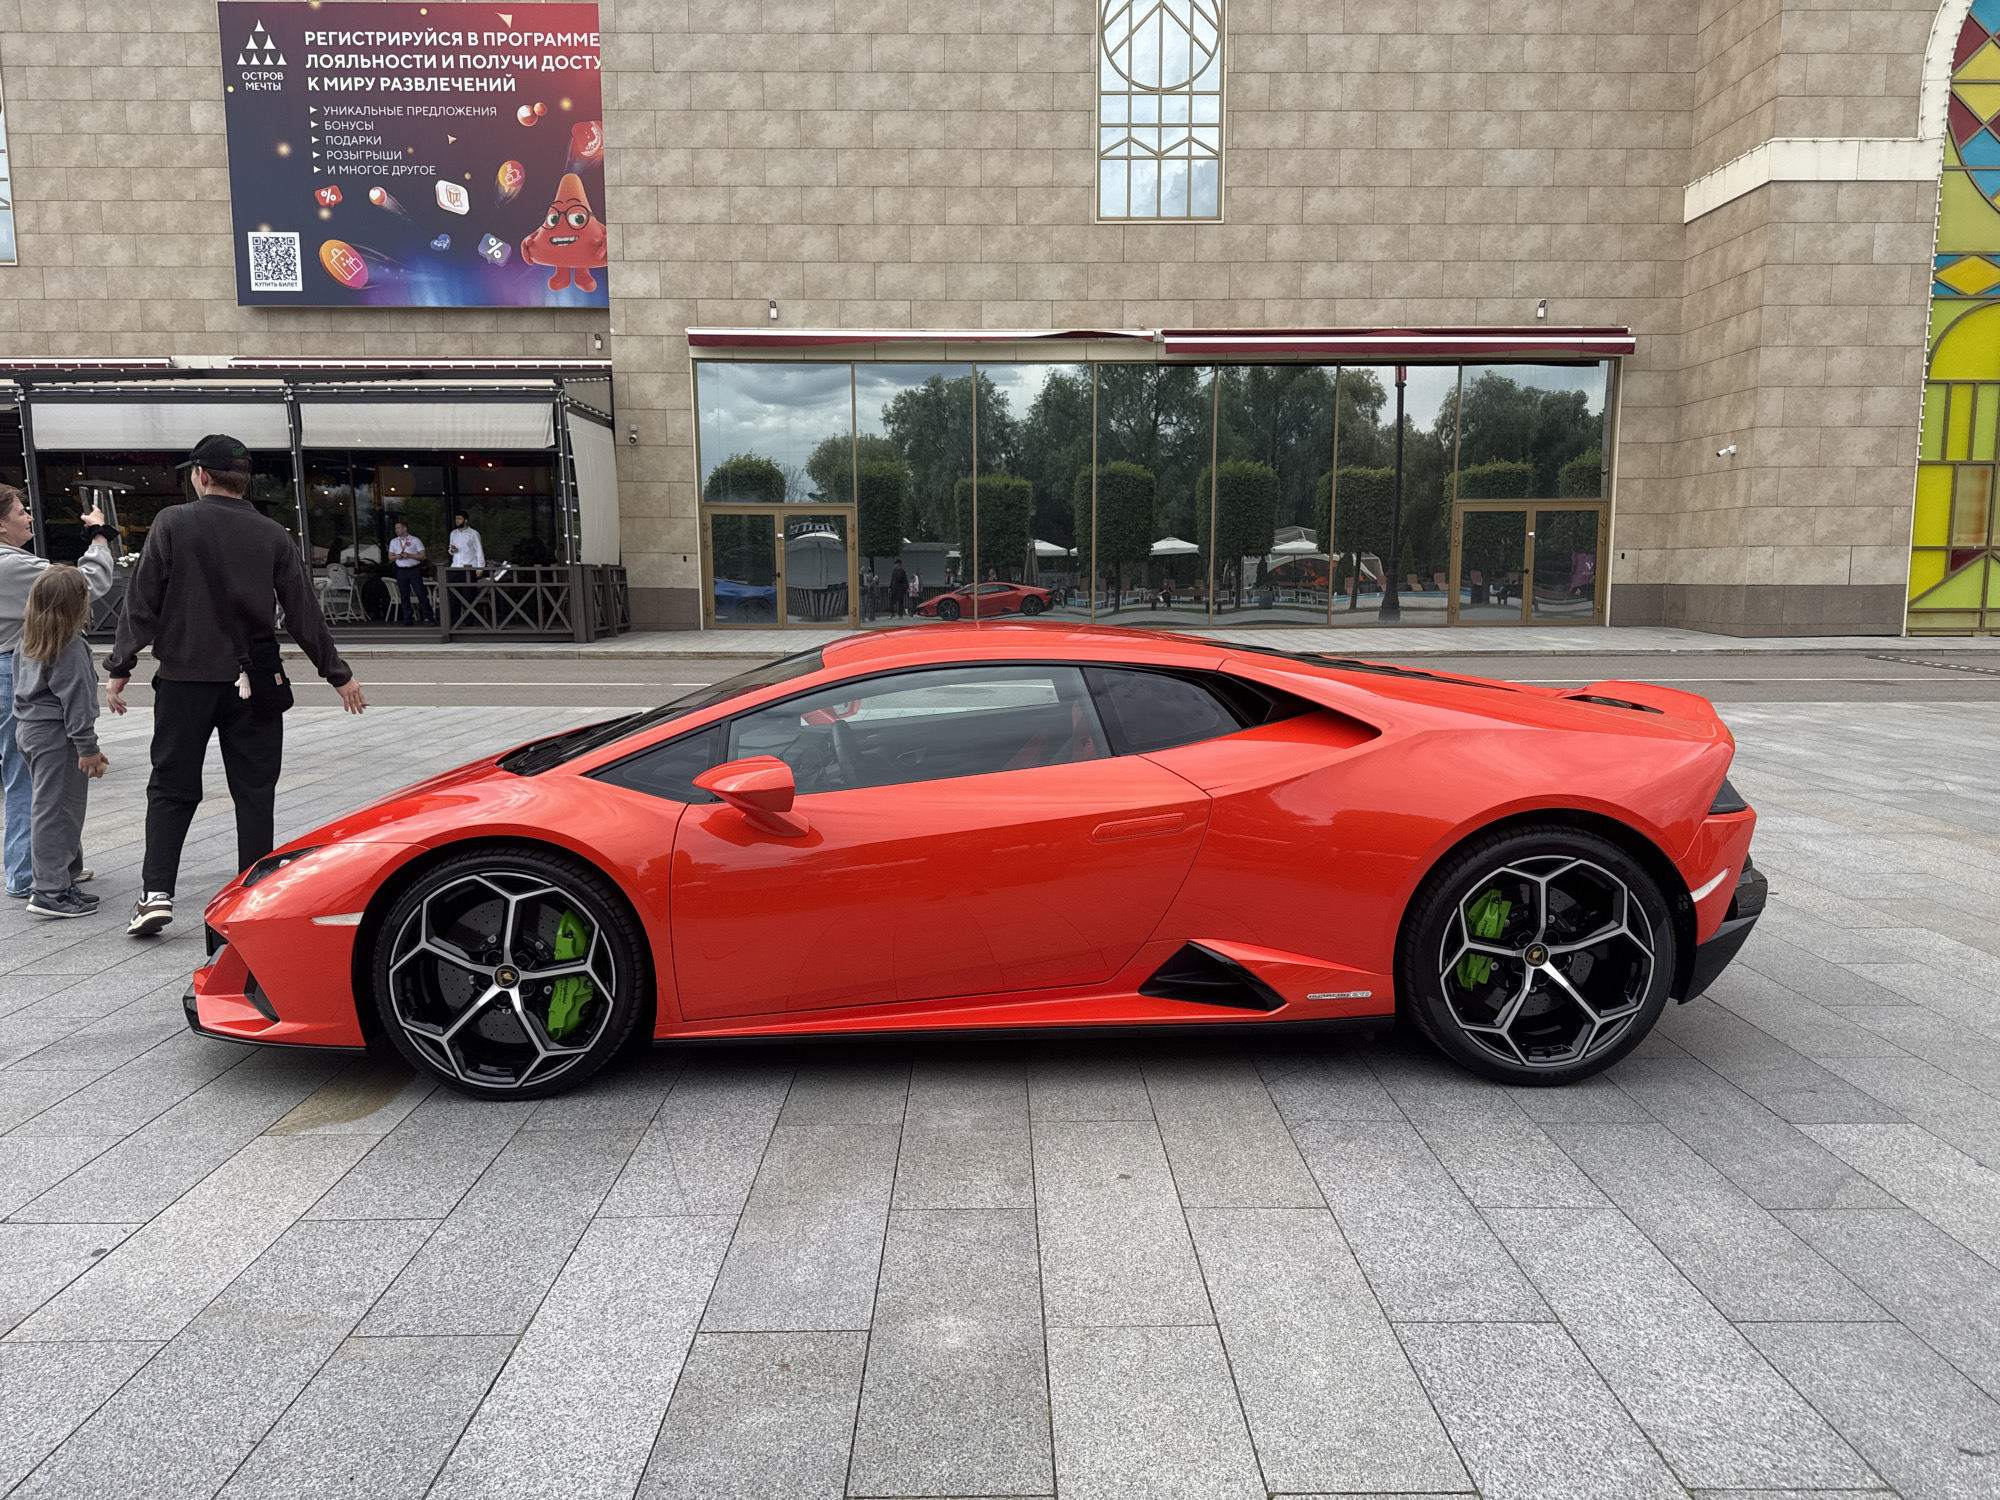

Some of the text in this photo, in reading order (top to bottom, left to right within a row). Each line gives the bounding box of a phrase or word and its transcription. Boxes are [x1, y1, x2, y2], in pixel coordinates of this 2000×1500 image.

[305, 28, 600, 47] РЕГИСТРИРУЙСЯ В ПРОГРАММЕ
[306, 54, 601, 72] ЛОЯЛЬНОСТИ И ПОЛУЧИ ДОСТУ
[242, 71, 284, 81] ОСТРОВ
[246, 82, 282, 91] МЕЧТЫ
[308, 74, 516, 92] К МИРУ РАЗВЛЕЧЕНИЙ
[323, 106, 497, 118] УНИКАЛЬНЫЕ ПРЕДЛОЖЕНИЯ
[325, 121, 374, 131] БОНУСЫ
[325, 136, 382, 147] ПОДАРКИ
[327, 151, 402, 161] РОЗЫГРЫШИ
[328, 166, 436, 177] И МНОГОЕ ДРУГОЕ
